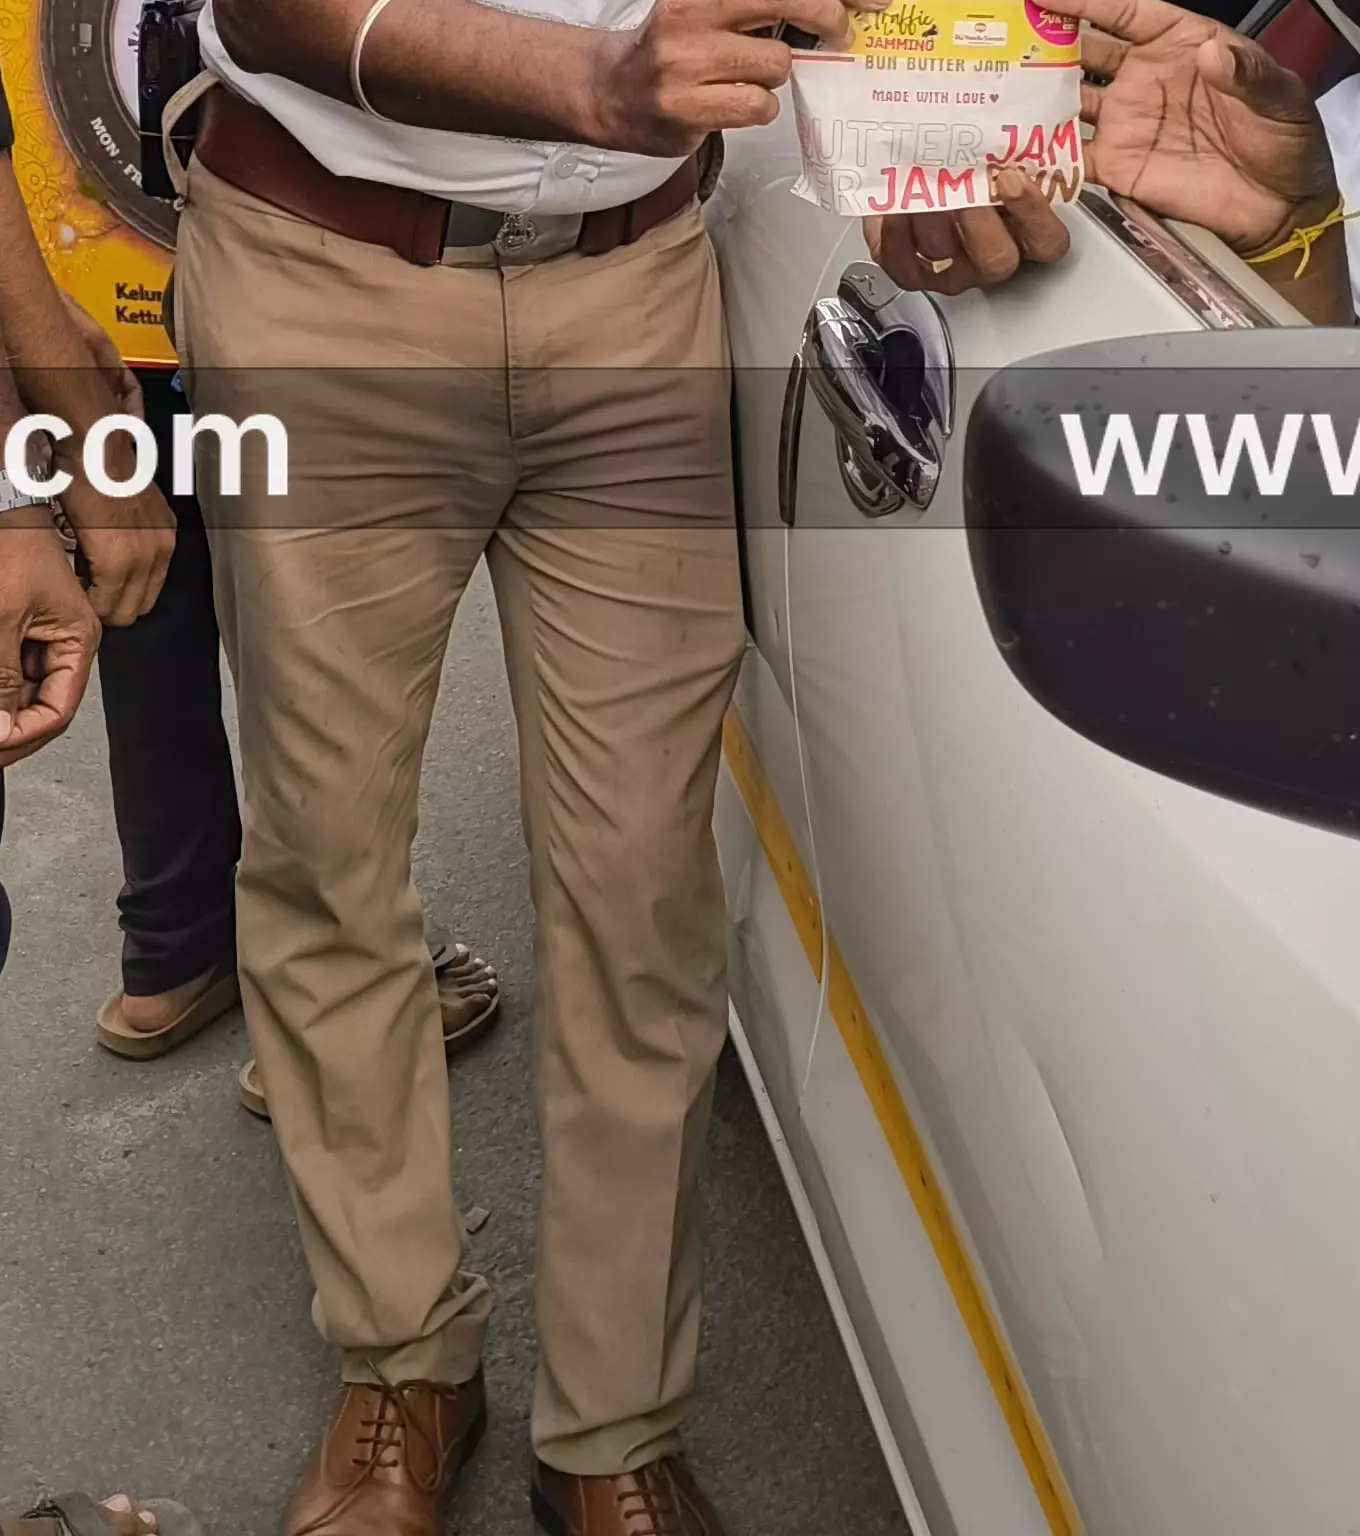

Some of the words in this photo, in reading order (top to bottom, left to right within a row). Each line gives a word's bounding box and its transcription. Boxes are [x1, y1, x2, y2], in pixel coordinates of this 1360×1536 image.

[864, 36, 936, 53] JAMMING
[864, 54, 898, 71] BUN
[906, 55, 967, 73] BUTTER
[973, 59, 1011, 73] JAM
[871, 89, 911, 105] MADE
[916, 89, 950, 105] WITH
[955, 91, 987, 105] LOVE
[90, 115, 121, 158] MON
[123, 163, 144, 189] FR
[985, 119, 1080, 166] JAM
[867, 165, 977, 212] JAM
